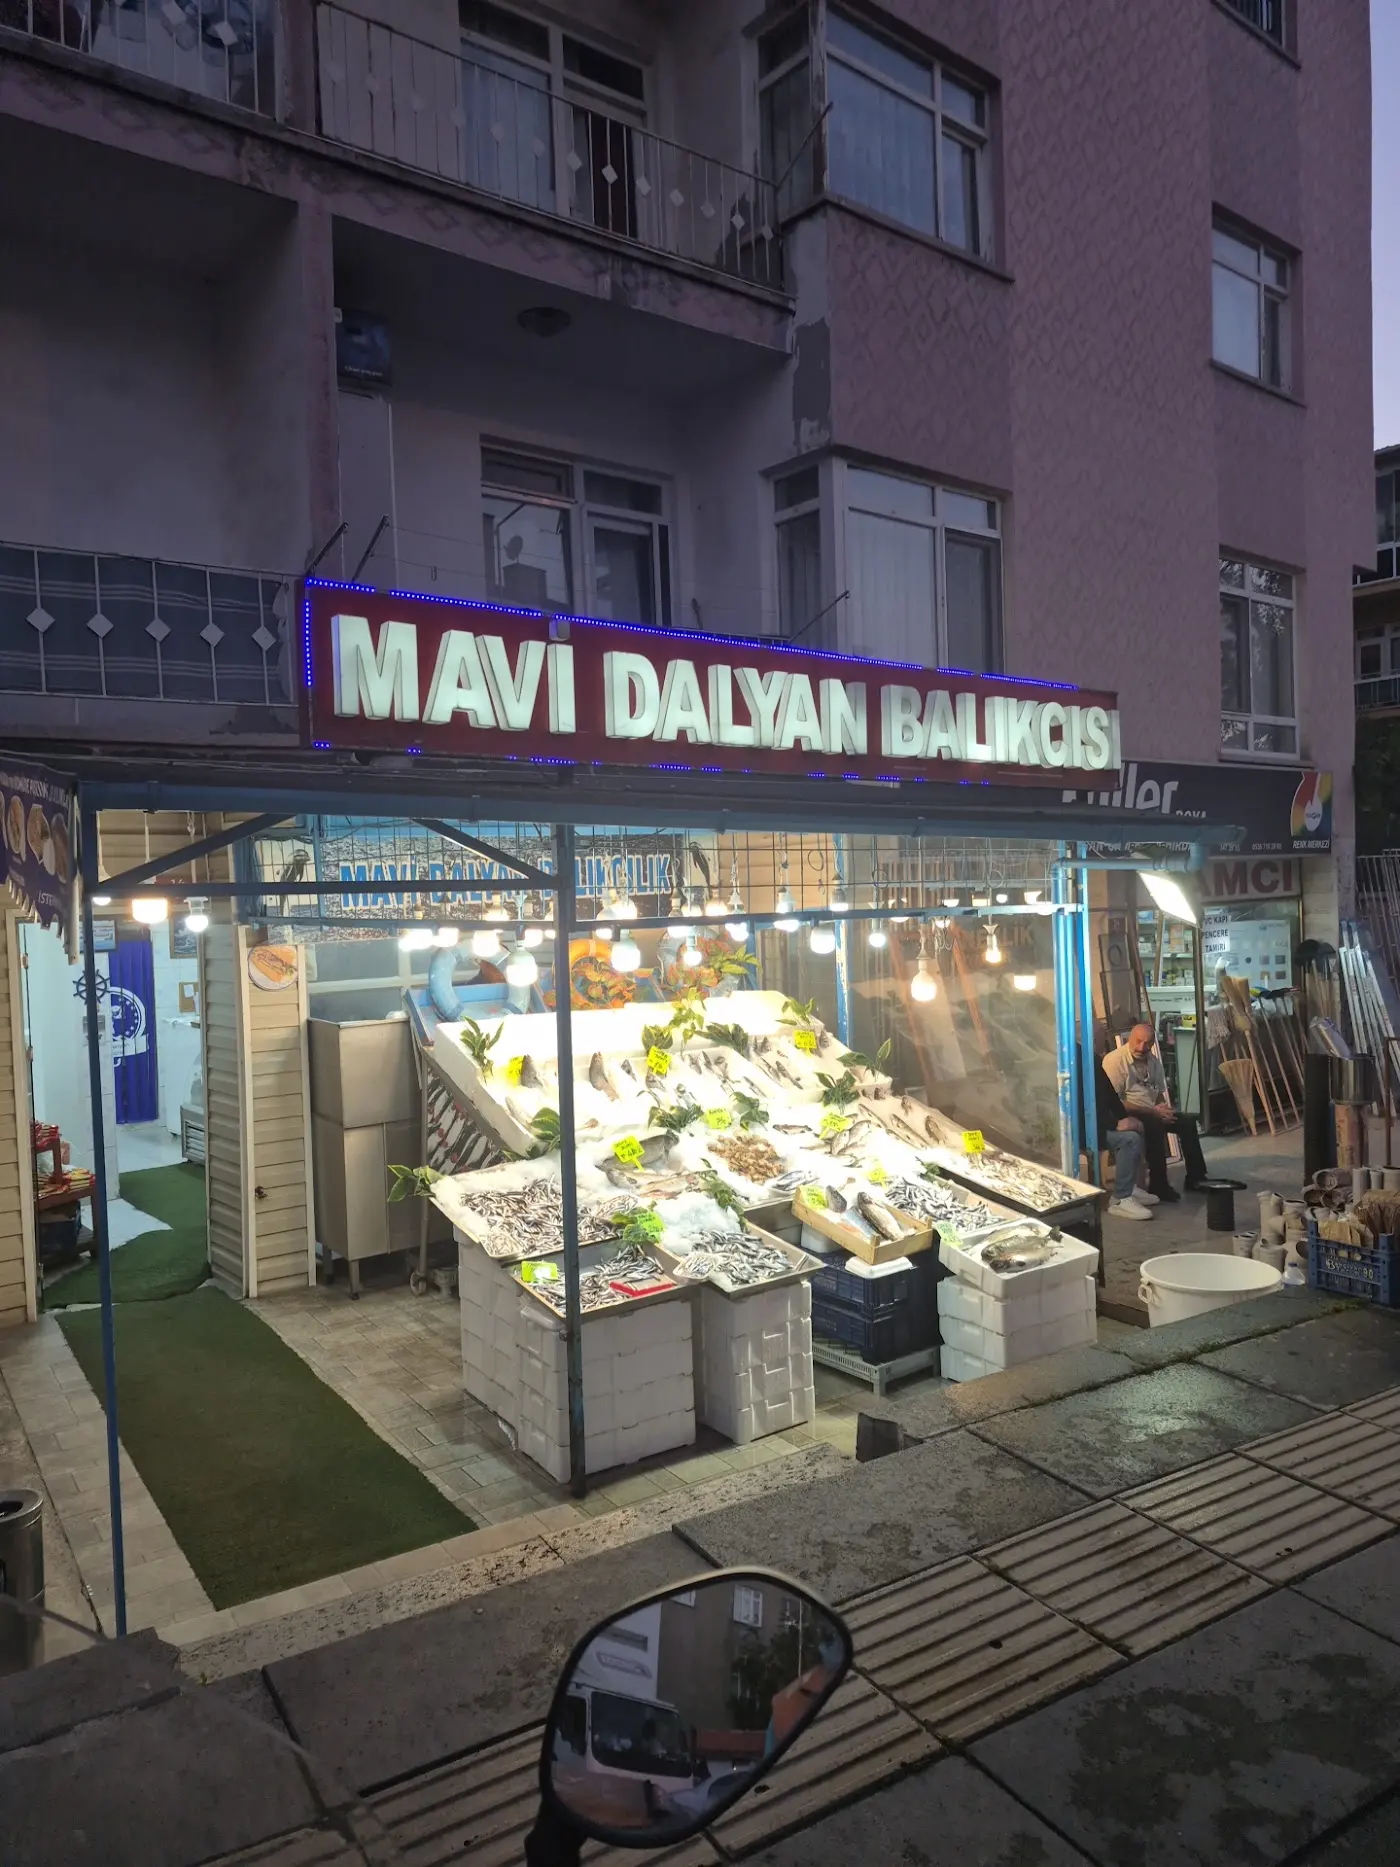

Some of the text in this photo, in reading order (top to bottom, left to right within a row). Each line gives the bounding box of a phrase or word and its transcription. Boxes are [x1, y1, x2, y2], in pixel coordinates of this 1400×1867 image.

[331, 614, 576, 734] MAVİ
[603, 651, 868, 756] DALYAN
[339, 851, 420, 910] MAVİ
